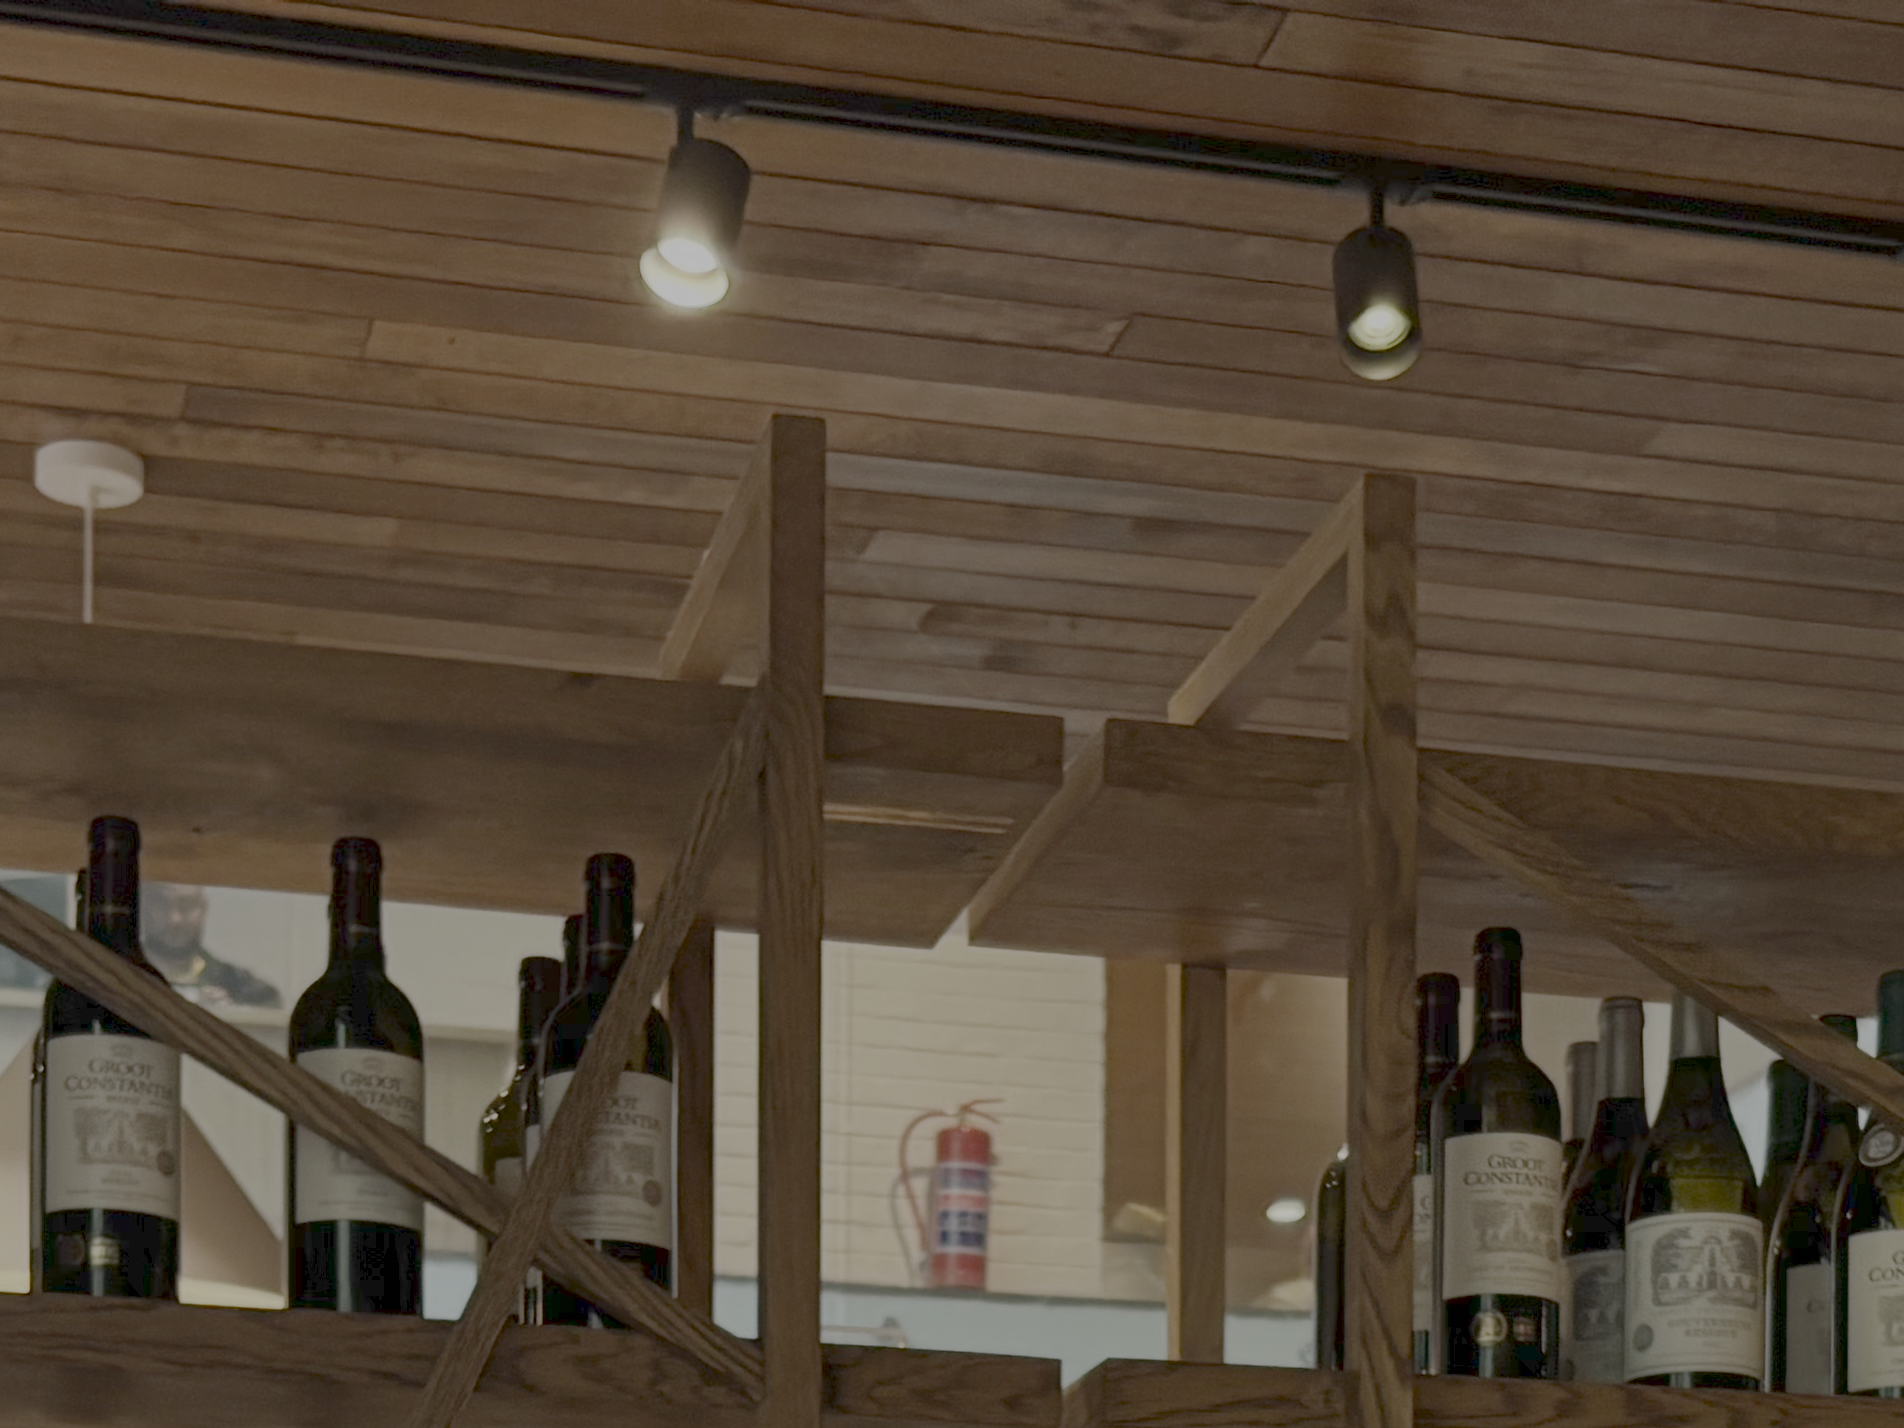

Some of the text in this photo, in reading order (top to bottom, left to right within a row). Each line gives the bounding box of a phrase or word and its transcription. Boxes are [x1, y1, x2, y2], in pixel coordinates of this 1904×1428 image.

[88, 1059, 152, 1079] GROOT
[341, 1070, 401, 1091] GROOT
[1487, 1154, 1544, 1172] GROOT
